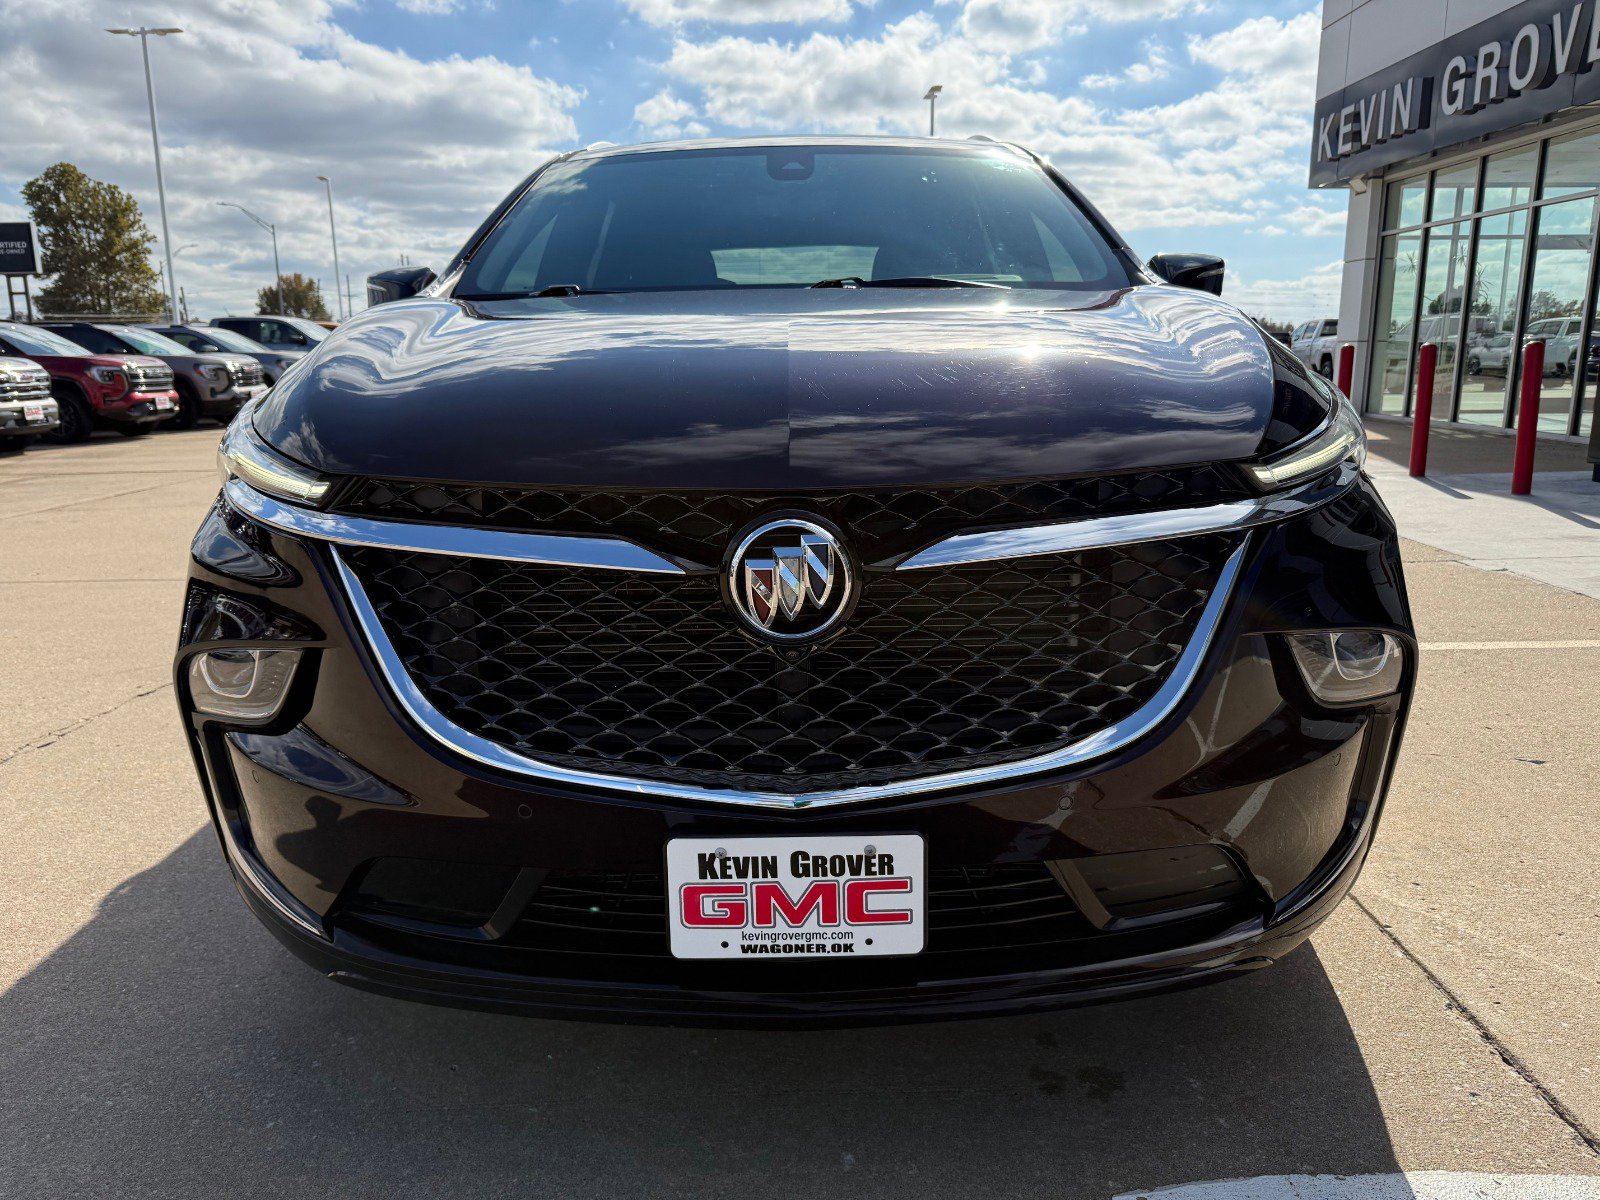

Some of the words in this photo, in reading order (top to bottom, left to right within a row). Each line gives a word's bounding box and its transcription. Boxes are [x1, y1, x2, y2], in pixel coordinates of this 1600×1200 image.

[1317, 77, 1416, 163] KEVIN
[679, 876, 913, 929] GMC
[741, 930, 854, 943] kevingrovergmc.com
